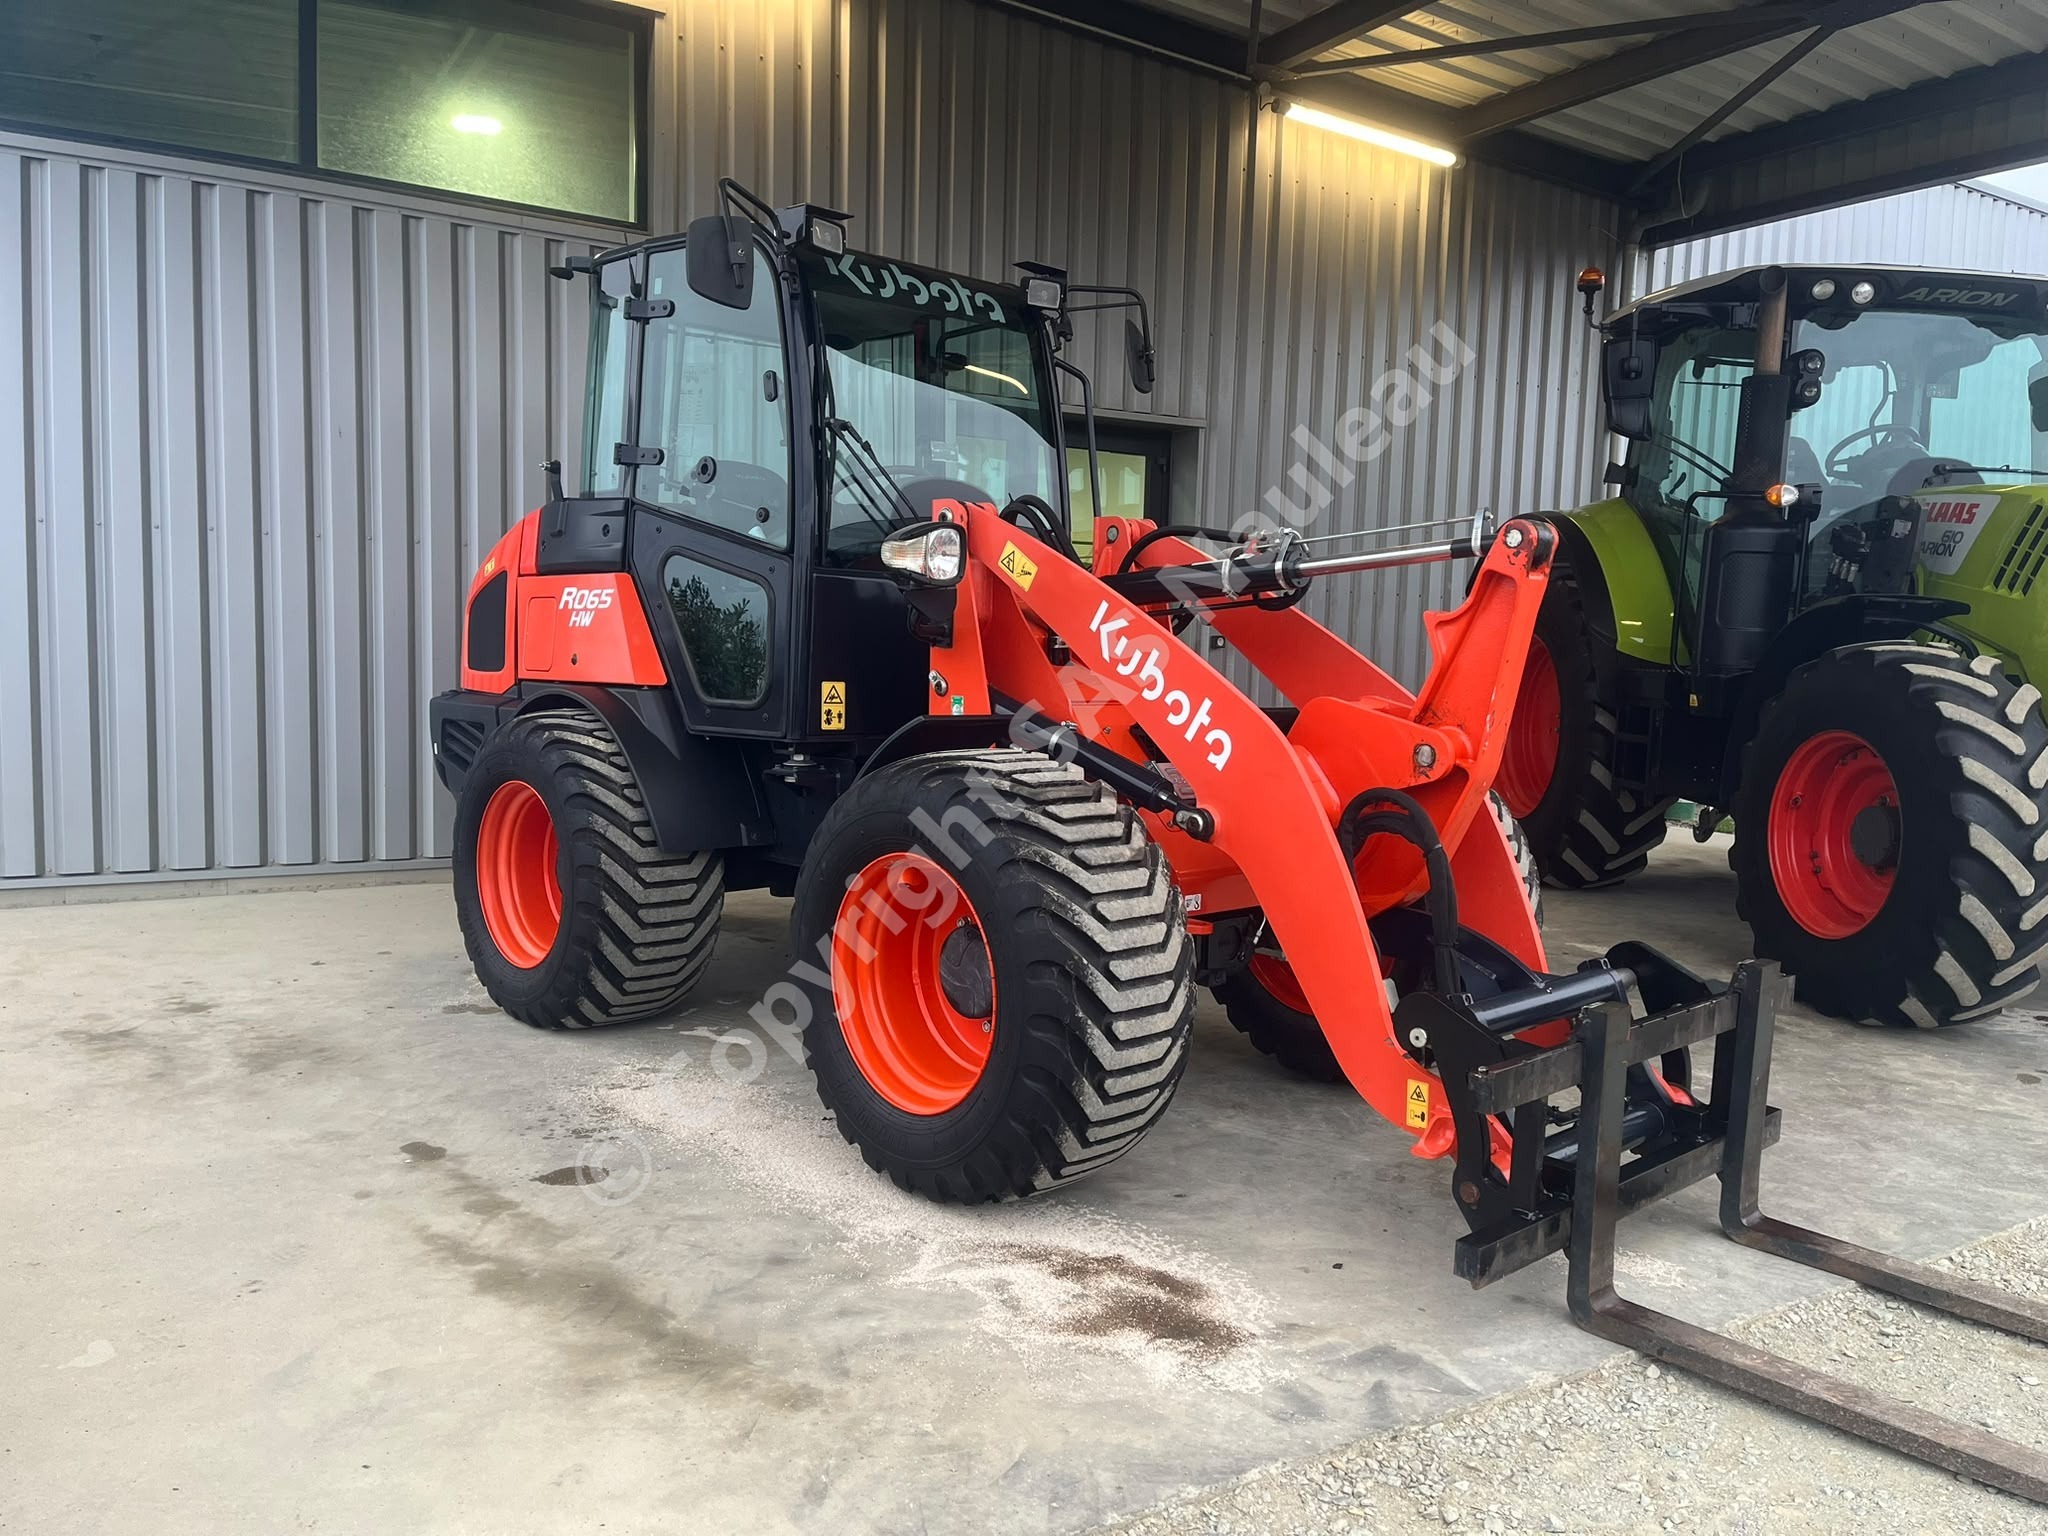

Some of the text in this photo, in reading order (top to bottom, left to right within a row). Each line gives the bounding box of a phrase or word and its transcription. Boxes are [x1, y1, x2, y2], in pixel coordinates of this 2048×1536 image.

[824, 254, 1006, 324] Kubota
[1926, 502, 1980, 525] LAAS
[1941, 530, 1964, 544] 610
[568, 610, 595, 627] HW
[1089, 600, 1232, 771] Kubota
